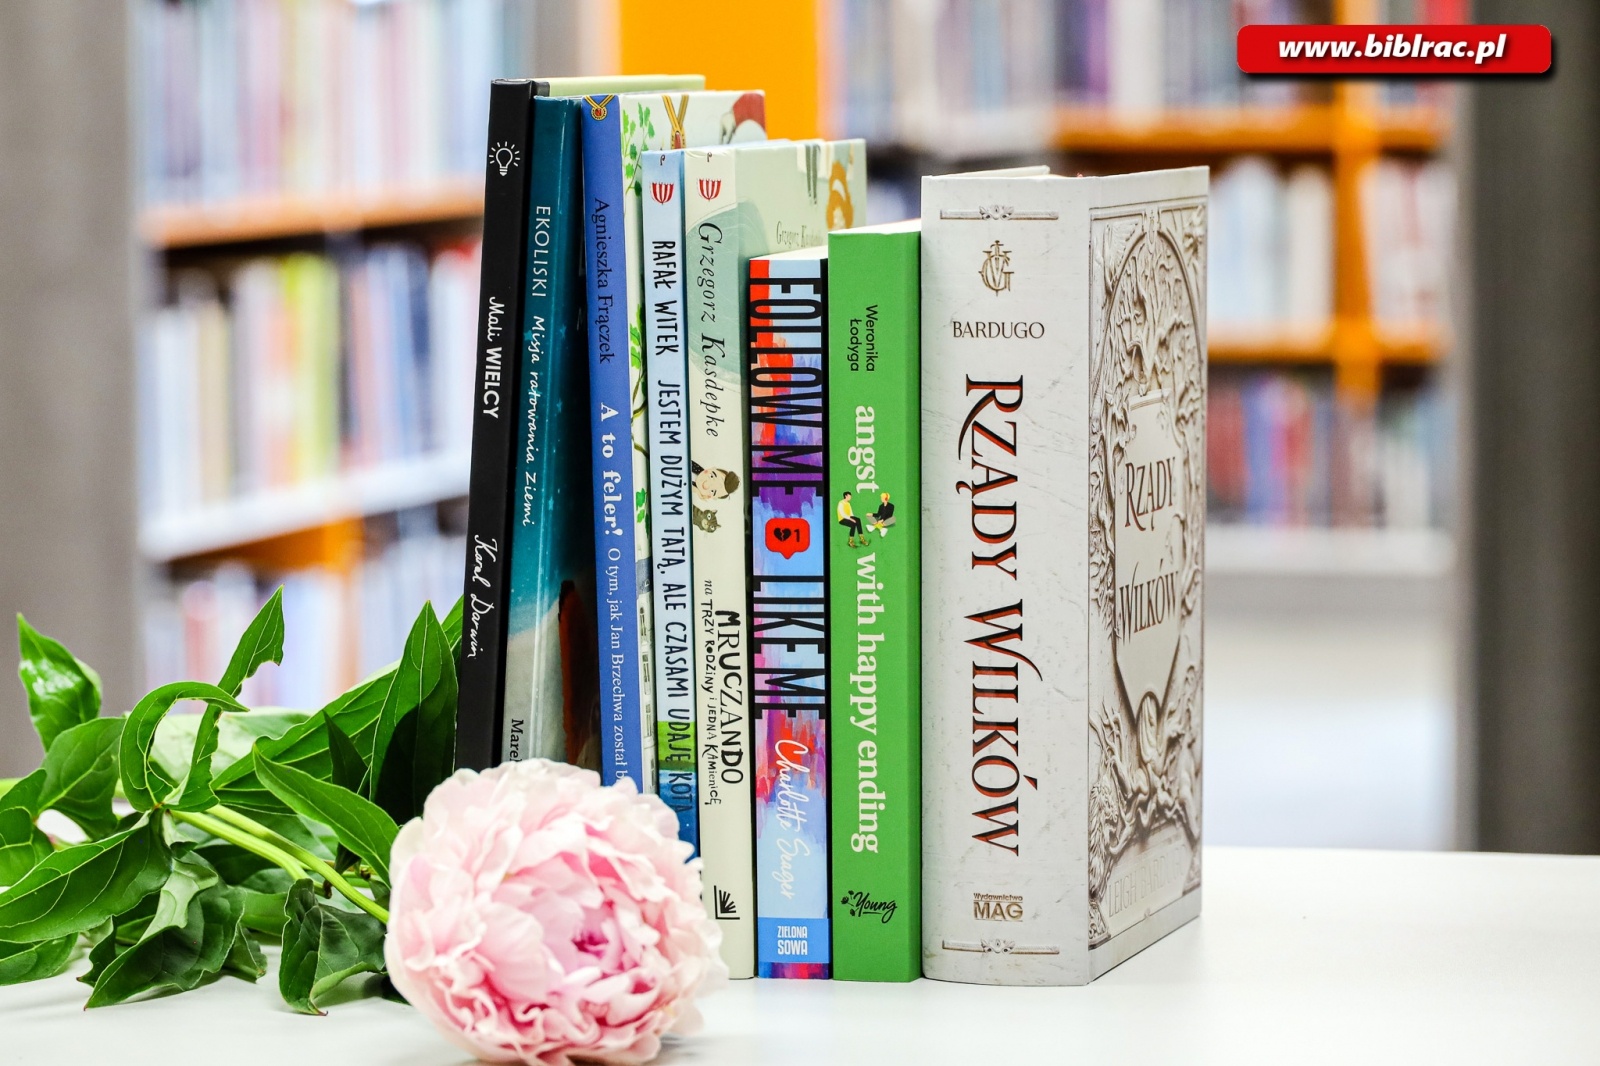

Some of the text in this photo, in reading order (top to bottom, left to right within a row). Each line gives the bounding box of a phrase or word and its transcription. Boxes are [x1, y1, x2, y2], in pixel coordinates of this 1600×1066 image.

[531, 205, 551, 298] EKOLISKI
[592, 197, 615, 365] Agnieszka Frączek
[651, 239, 680, 356] RAFAŁ WITEK
[697, 221, 726, 438] Grzegorz Kasdepke
[951, 320, 1046, 340] BARDUGO
[483, 296, 505, 419] Mali WIELCY
[528, 315, 545, 365] Misja
[846, 317, 863, 373] Łodyga
[864, 304, 879, 373] Weronika
[524, 371, 545, 464] ratowania
[749, 277, 826, 497] FOLLOW ME
[600, 403, 623, 537] A to feler!
[1125, 456, 1176, 532] RZĄDY
[607, 548, 621, 561] O
[793, 528, 801, 543] 1
[467, 534, 499, 658] Karol Darwin
[605, 565, 619, 596] tym,
[606, 599, 623, 622] jak
[656, 379, 693, 813] JESTEM DUŻYM TATĄ, ALE CZASAMI UDAJĘ KOTA
[704, 579, 713, 595] na
[955, 373, 1044, 857] RZĄDY WILKÓW
[1119, 558, 1179, 647] WILKÓW
[610, 625, 624, 650] Jan
[701, 599, 714, 635] TRZY
[753, 575, 827, 720] LIKE ME
[847, 405, 887, 854] angst with happy ending
[611, 653, 626, 723] Brzechwa
[707, 702, 719, 742] JEDNA
[715, 609, 744, 784] MRUCZANDO
[509, 718, 524, 762] Mare
[613, 725, 628, 766] został
[771, 739, 811, 900] Charlotte Seager
[852, 891, 898, 924] Young
[973, 892, 1024, 901] Wydawnictwo
[973, 901, 1024, 920] MAG
[776, 925, 809, 939] ZIELONA
[776, 940, 809, 956] SOWA
